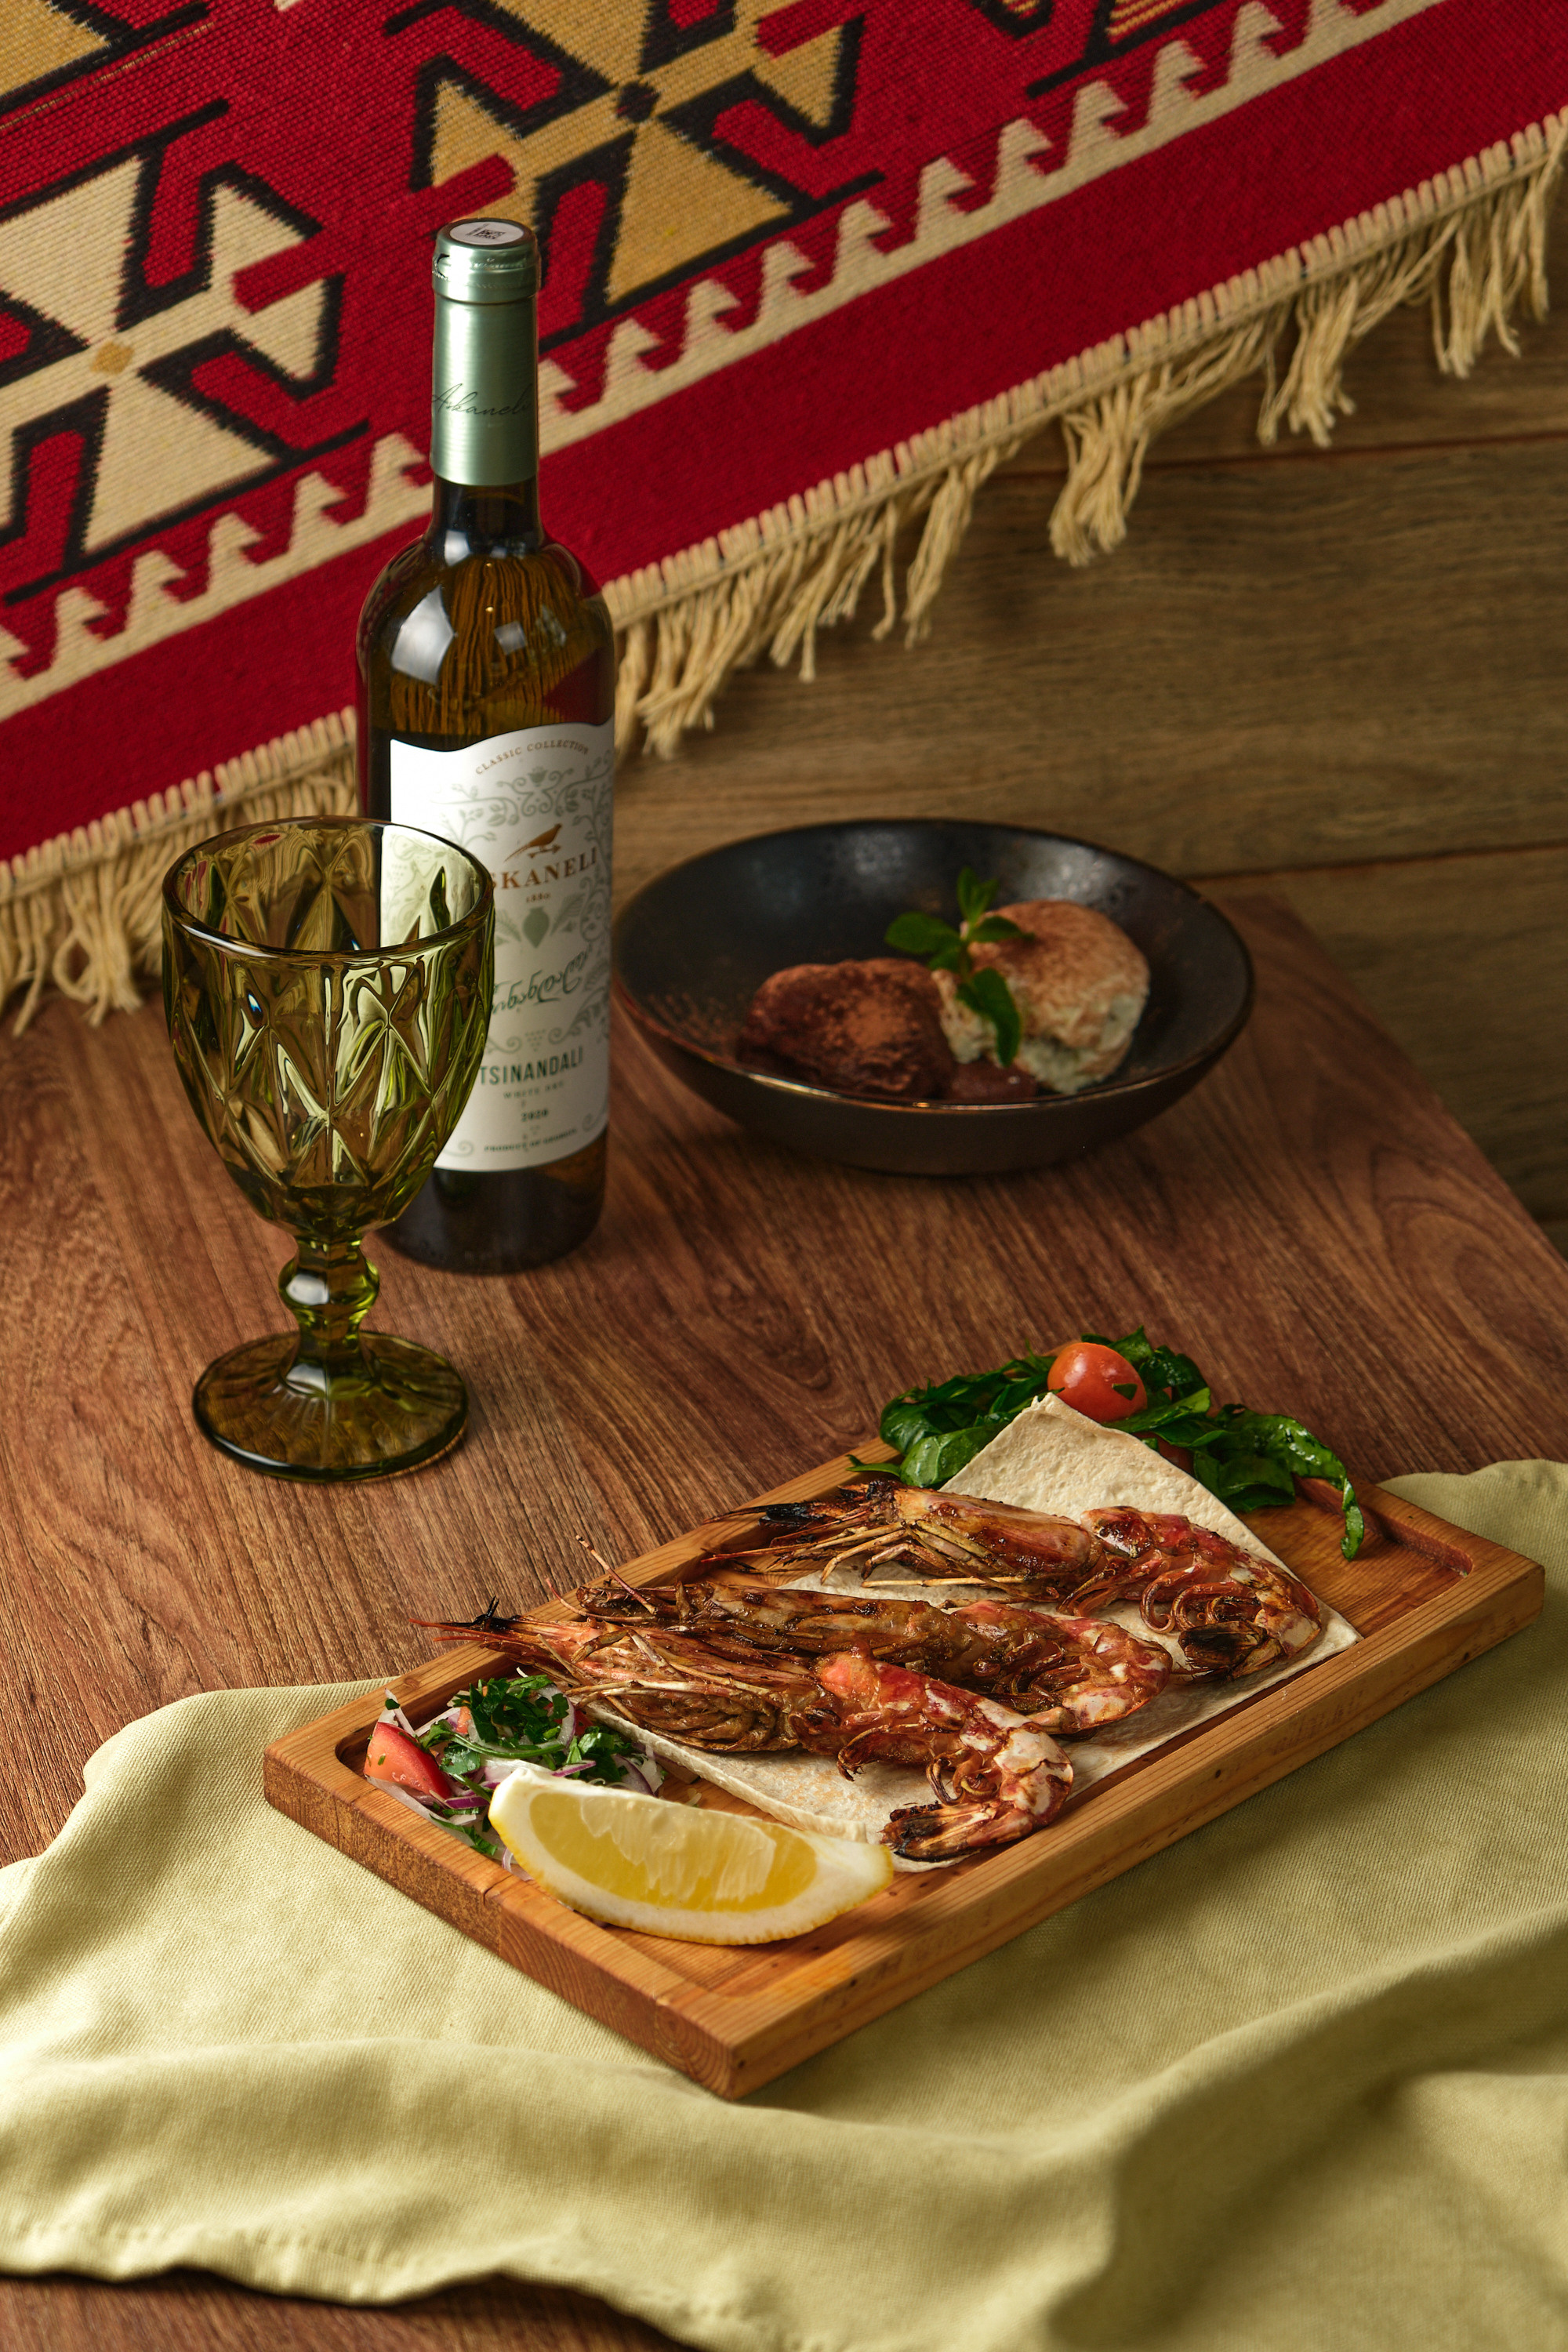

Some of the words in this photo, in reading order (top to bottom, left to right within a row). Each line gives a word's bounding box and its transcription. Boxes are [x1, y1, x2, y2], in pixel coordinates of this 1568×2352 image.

[475, 746, 522, 775] CLASSIC
[526, 739, 590, 756] COLLECTION
[479, 1046, 584, 1085] TSINANDALI
[503, 1087, 541, 1099] WHITE
[521, 1107, 550, 1123] 2020
